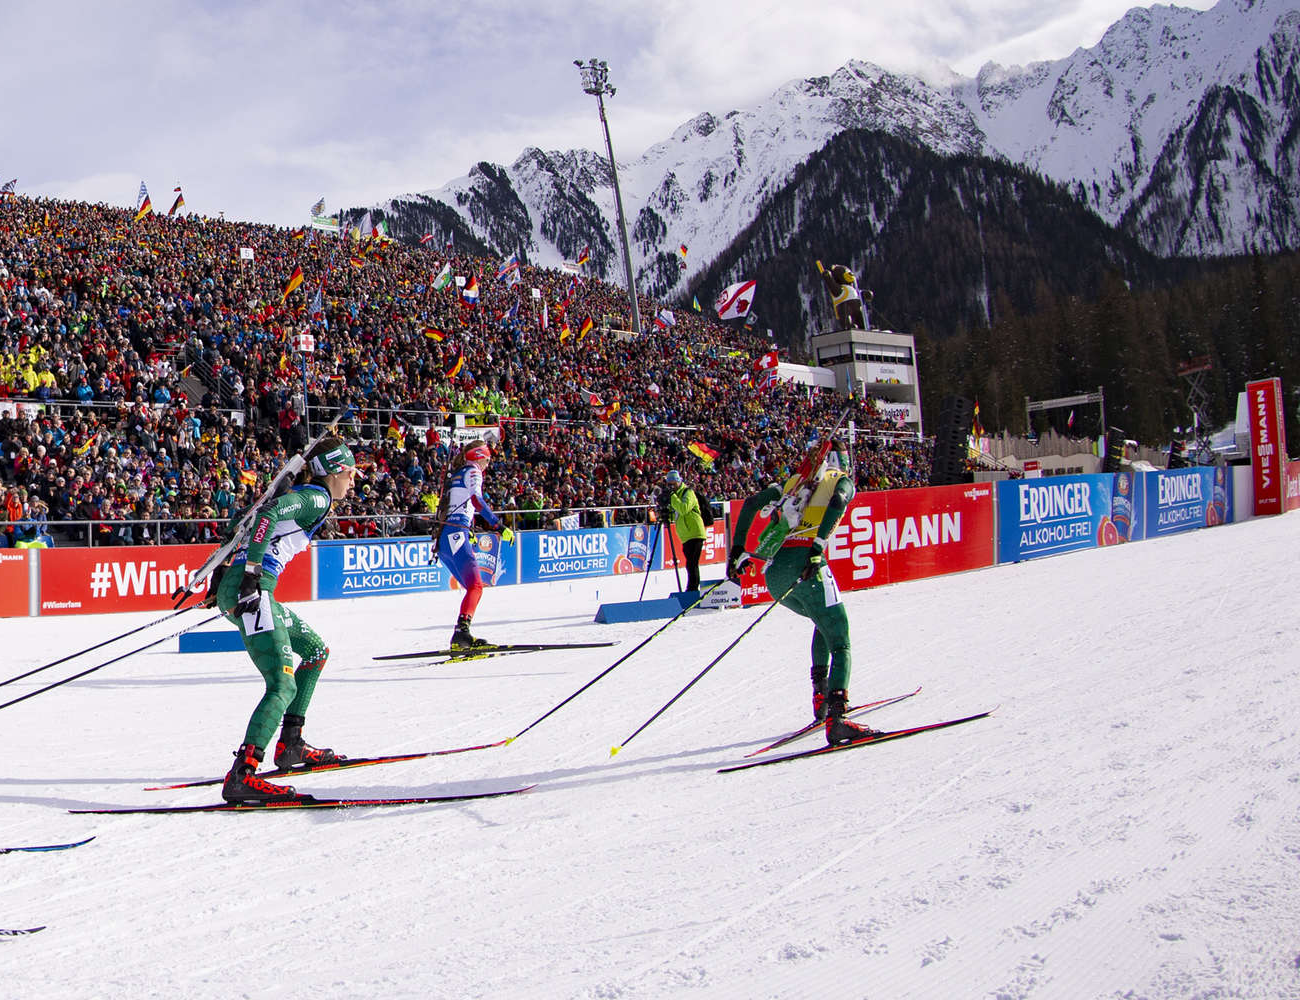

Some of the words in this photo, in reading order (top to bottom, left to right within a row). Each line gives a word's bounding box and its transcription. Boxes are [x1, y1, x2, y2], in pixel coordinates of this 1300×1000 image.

[1256, 389, 1274, 489] VIESSMANN
[1158, 472, 1203, 506] ERDINGER
[1019, 482, 1093, 524] ERDINGER
[1158, 505, 1203, 526] ALKOHOLFREI
[538, 533, 609, 560] ERDINGER
[828, 506, 962, 581] ESSMANN
[1019, 520, 1092, 548] ALKOHOLFREI
[538, 557, 608, 575] ALKOHOLFREI
[342, 571, 441, 589] ALKOHOLFREI
[253, 608, 265, 632] 2
